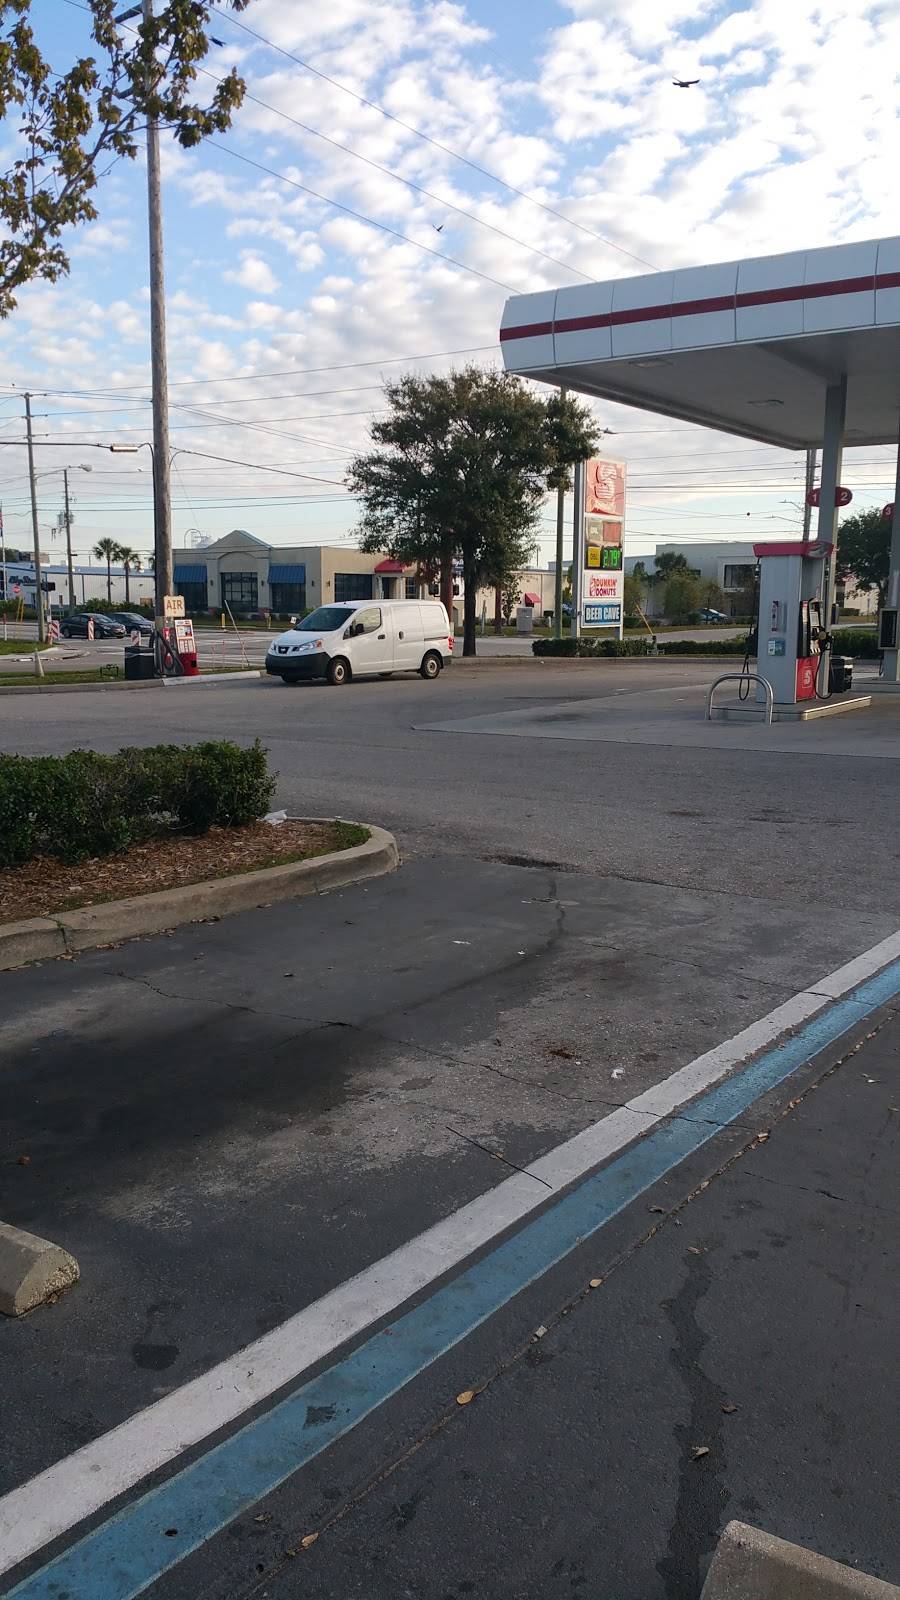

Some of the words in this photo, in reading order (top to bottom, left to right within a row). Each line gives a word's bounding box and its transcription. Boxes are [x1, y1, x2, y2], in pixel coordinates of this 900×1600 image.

[812, 494, 817, 502] 1
[841, 492, 848, 501] 2
[885, 507, 891, 515] 3
[595, 588, 616, 596] DONUTS
[166, 599, 183, 610] AIR
[586, 607, 602, 620] BEER
[604, 607, 620, 620] CAVE
